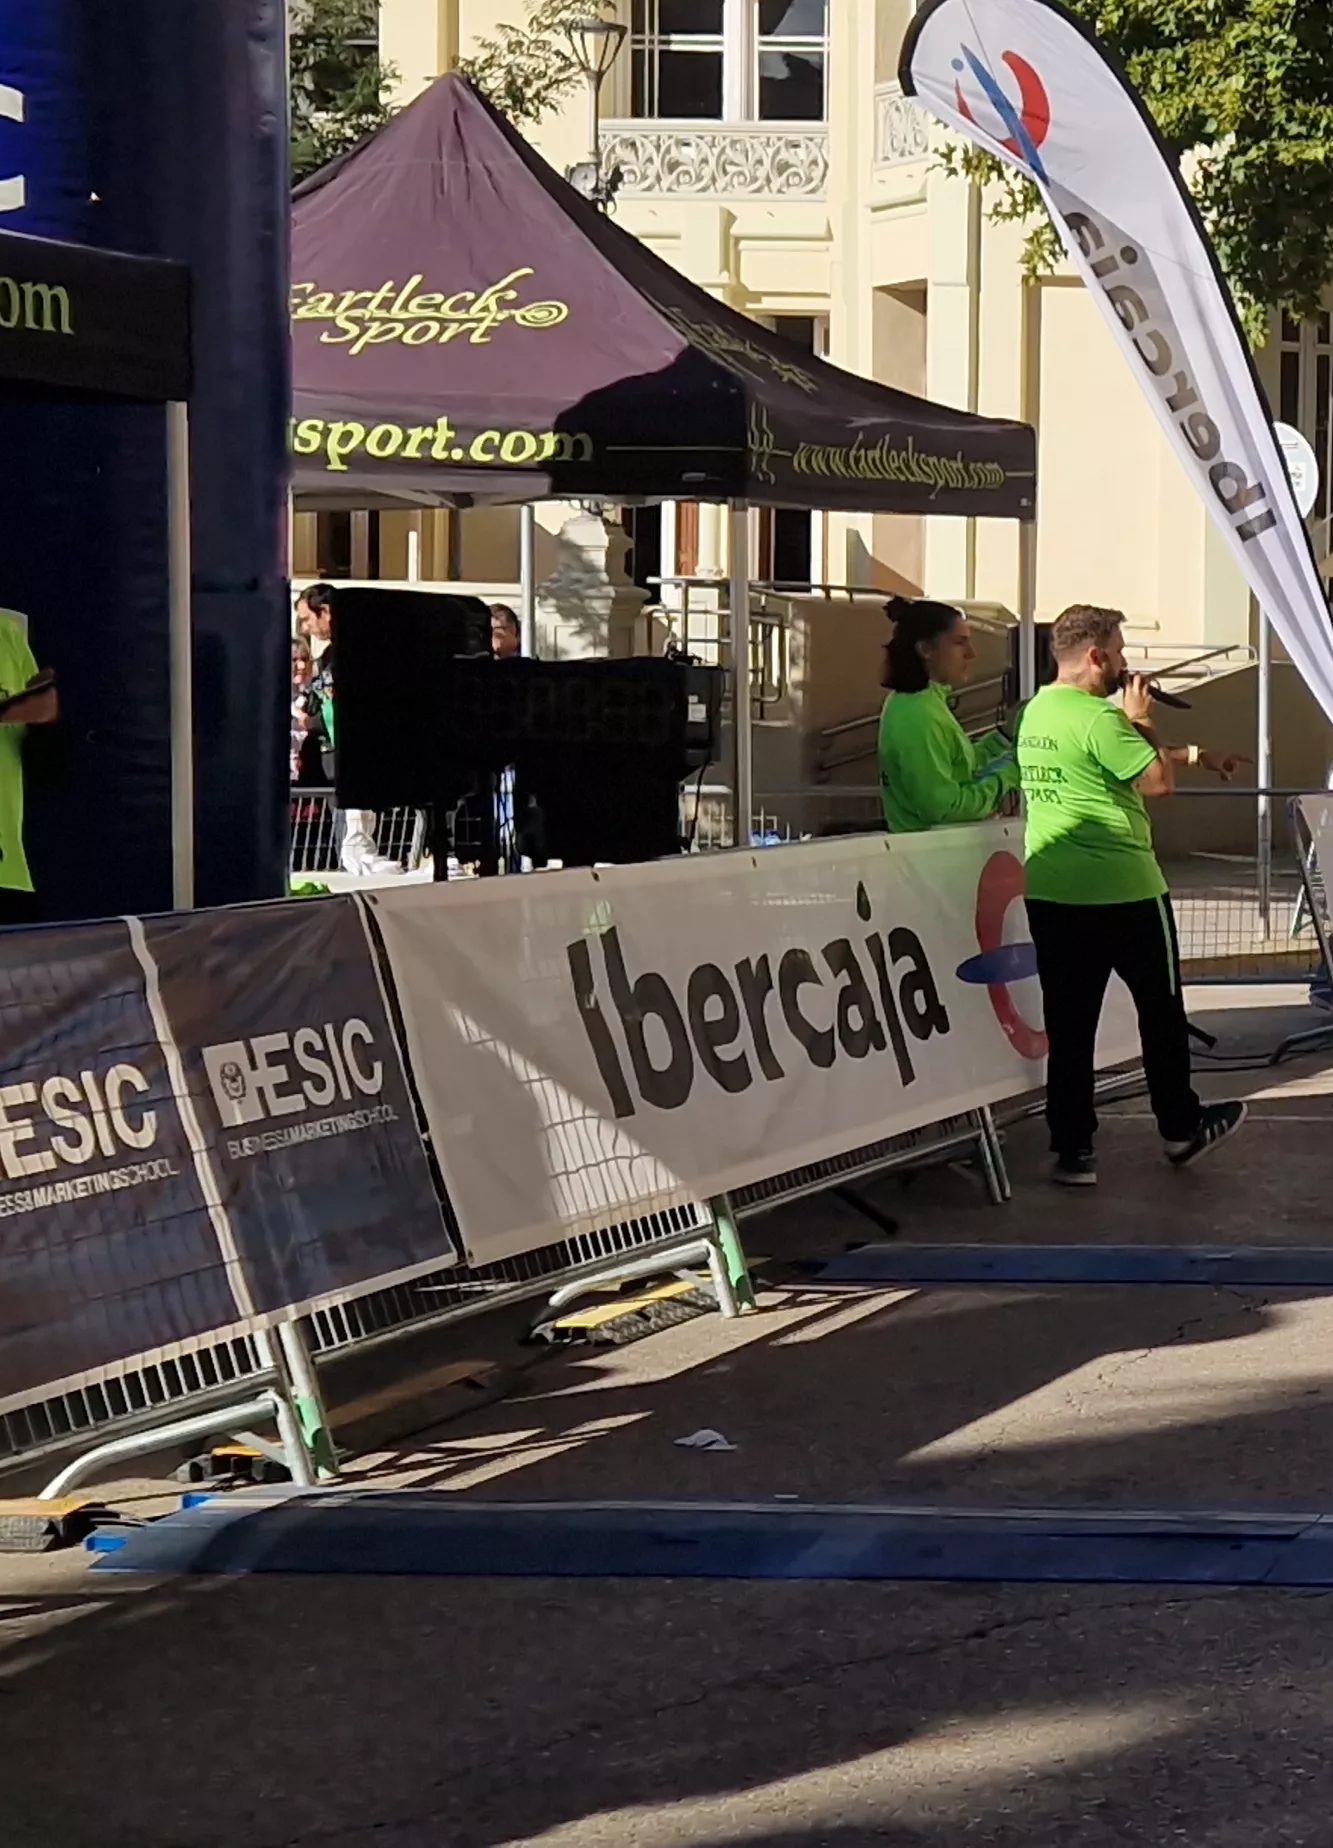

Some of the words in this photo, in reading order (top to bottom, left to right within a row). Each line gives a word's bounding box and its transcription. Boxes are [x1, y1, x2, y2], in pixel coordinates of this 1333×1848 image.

[319, 306, 503, 356] Sport
[286, 416, 594, 471] sport.com
[566, 880, 951, 1119] Ibercaja
[250, 1017, 385, 1118] ESIC
[0, 1063, 158, 1180] ESIC
